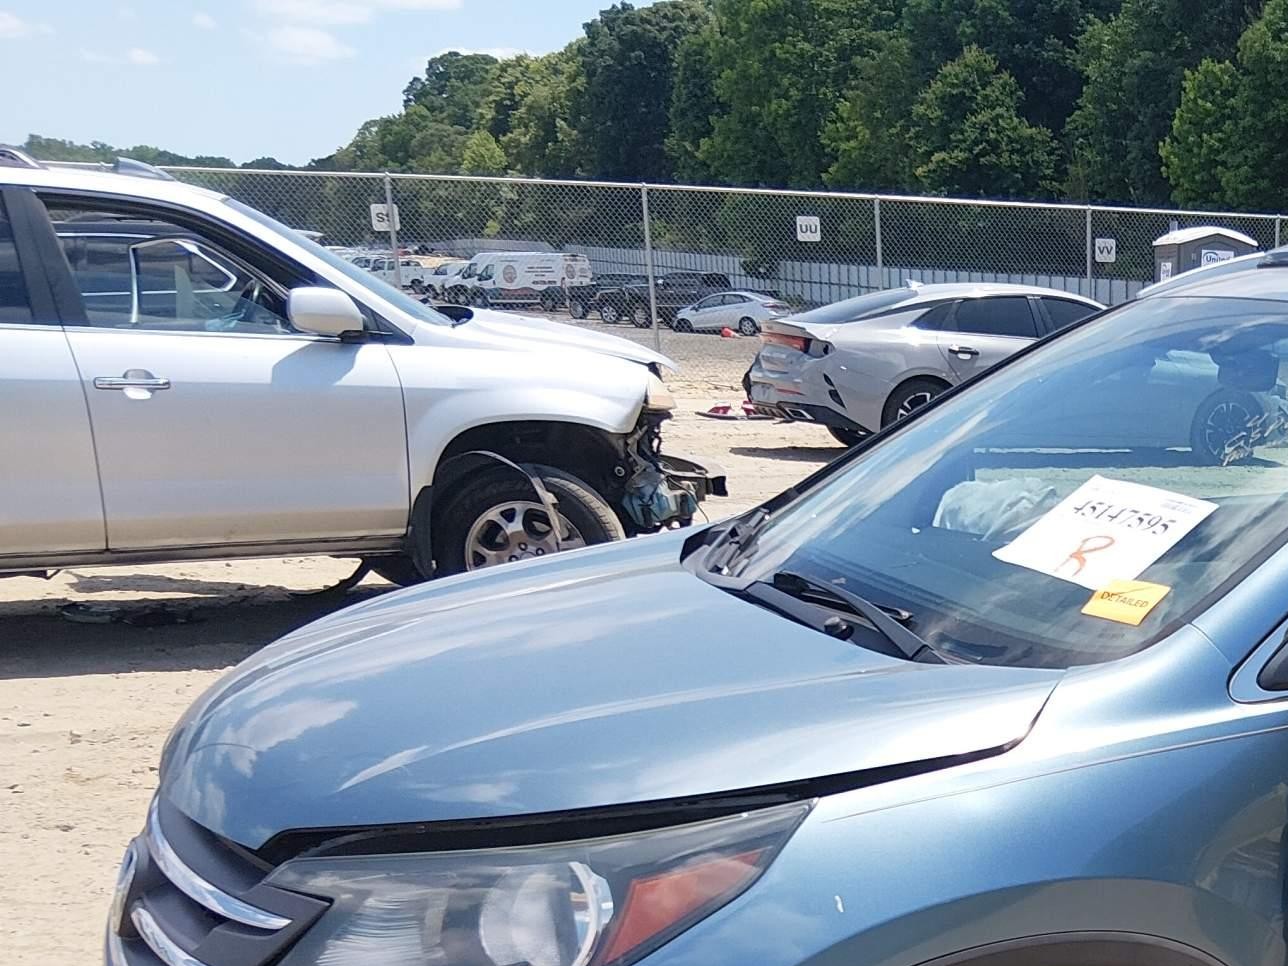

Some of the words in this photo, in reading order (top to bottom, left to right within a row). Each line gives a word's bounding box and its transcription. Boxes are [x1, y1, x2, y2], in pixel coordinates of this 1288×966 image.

[800, 223, 818, 234] UU
[1073, 499, 1177, 536] 45147595
[1100, 590, 1150, 609] DETAILED
